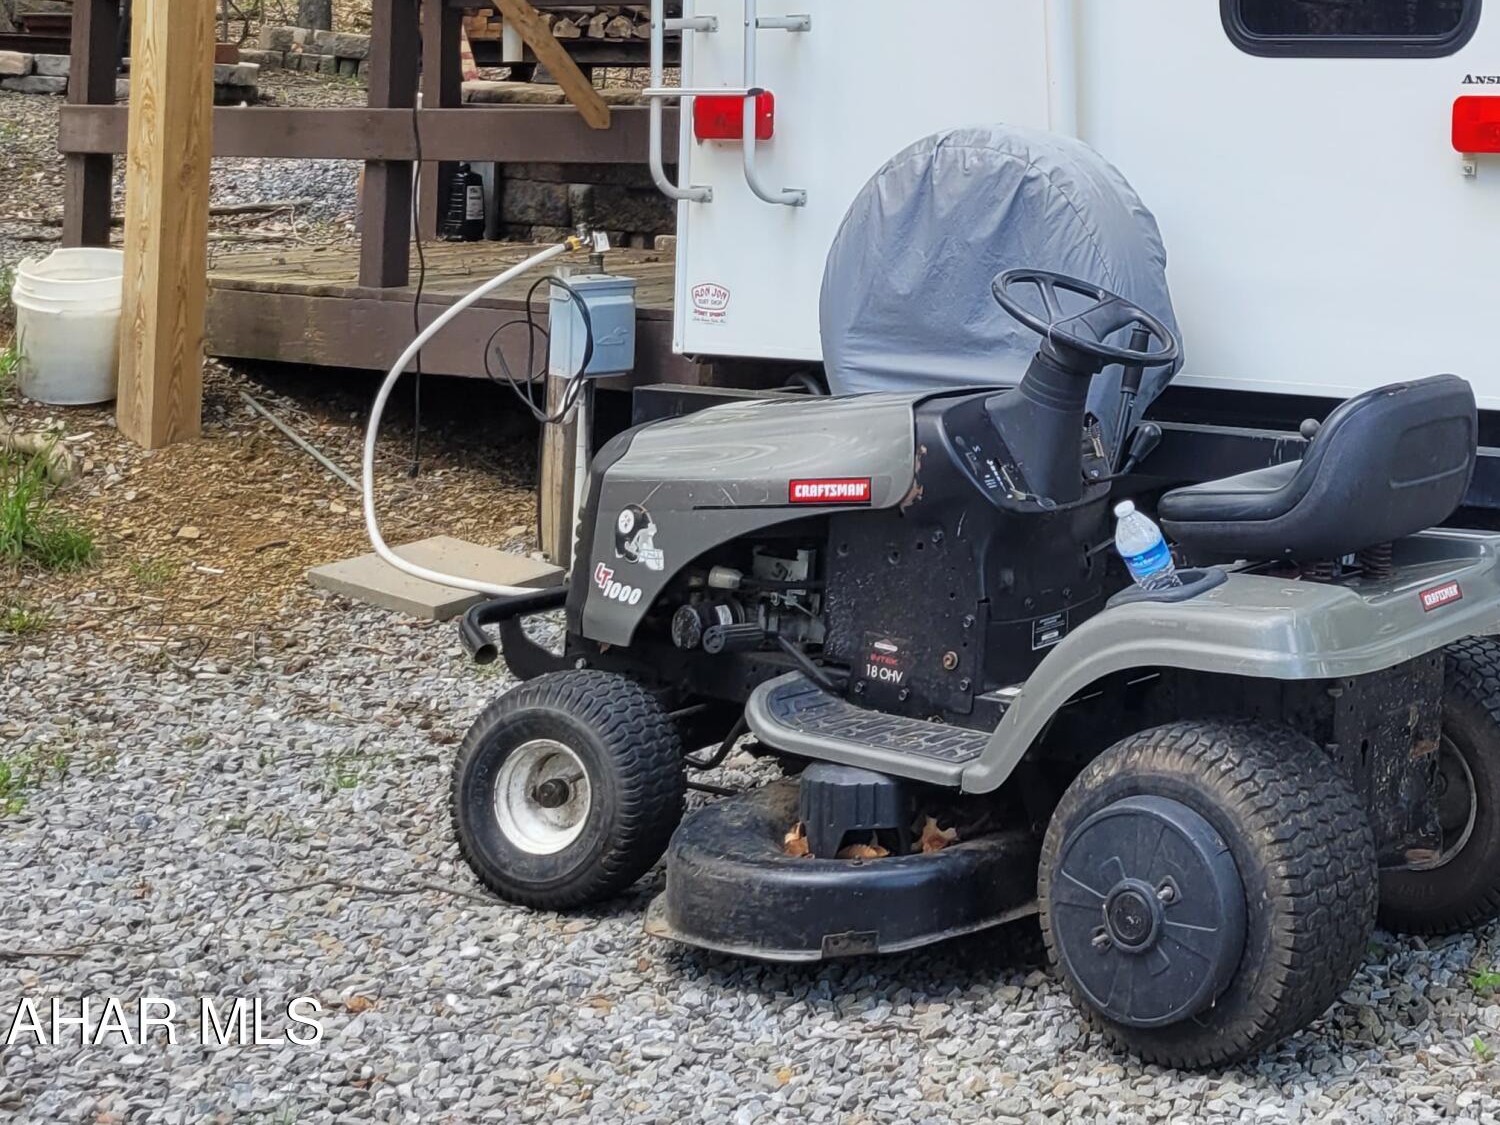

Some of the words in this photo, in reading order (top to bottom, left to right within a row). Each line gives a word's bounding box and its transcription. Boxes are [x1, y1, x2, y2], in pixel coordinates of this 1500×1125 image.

[795, 483, 867, 498] CRAFTSMAN
[866, 664, 878, 678] 18
[879, 667, 903, 684] OHV
